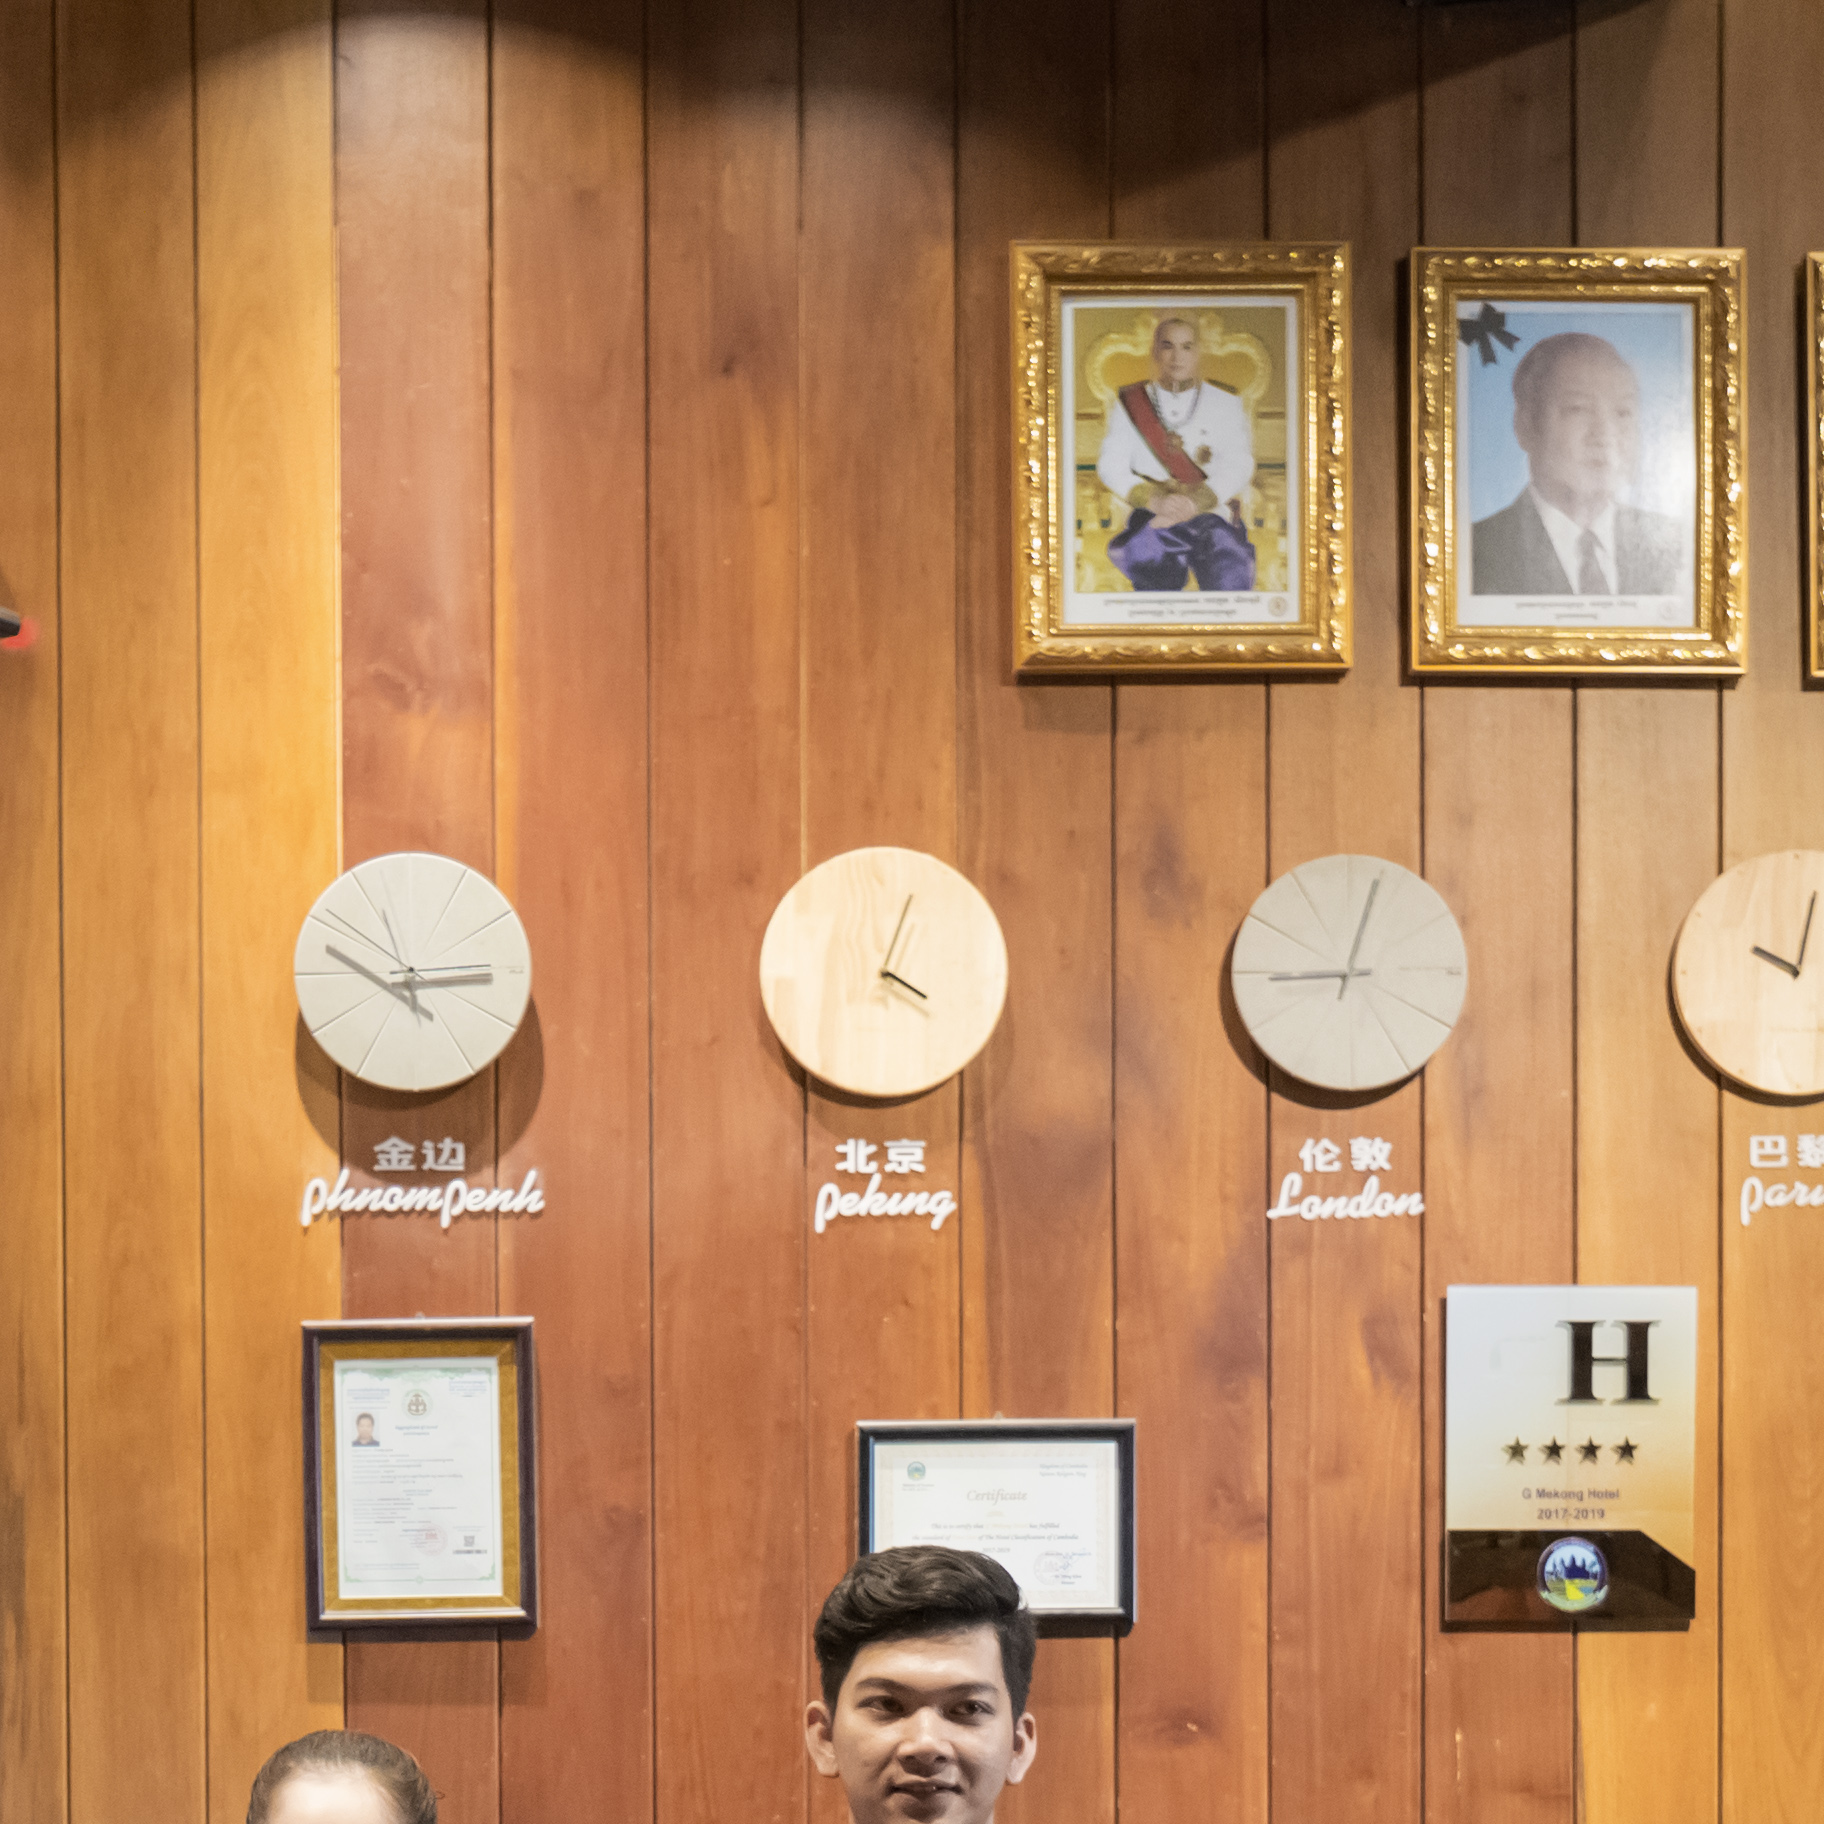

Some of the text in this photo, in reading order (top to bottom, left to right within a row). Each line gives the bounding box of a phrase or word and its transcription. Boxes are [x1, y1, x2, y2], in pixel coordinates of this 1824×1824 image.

[373, 1135, 466, 1172] 金边
[834, 1138, 926, 1174] 北京
[1298, 1135, 1393, 1172] 伦敦
[1266, 1171, 1425, 1220] London
[1555, 1318, 1661, 1406] H
[966, 1488, 1028, 1505] Certificate
[1522, 1487, 1620, 1501] G Mekong Hotel
[1537, 1508, 1605, 1520] 2017-2019
